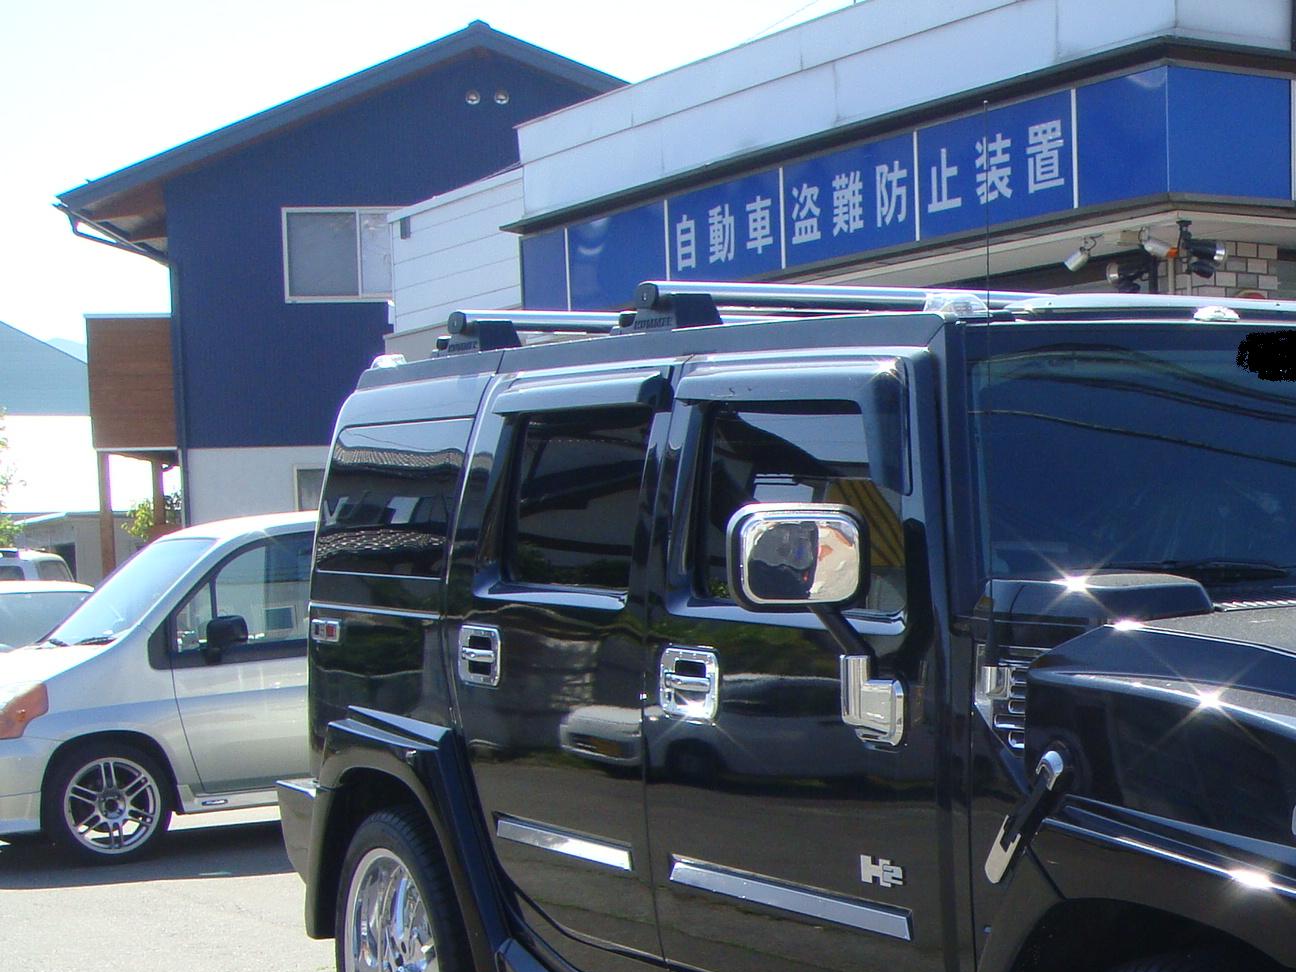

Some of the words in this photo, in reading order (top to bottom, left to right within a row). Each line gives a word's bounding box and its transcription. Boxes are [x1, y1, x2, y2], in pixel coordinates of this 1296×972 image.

[675, 119, 1065, 272] 自動車盗難防止装置
[860, 854, 904, 888] H2
